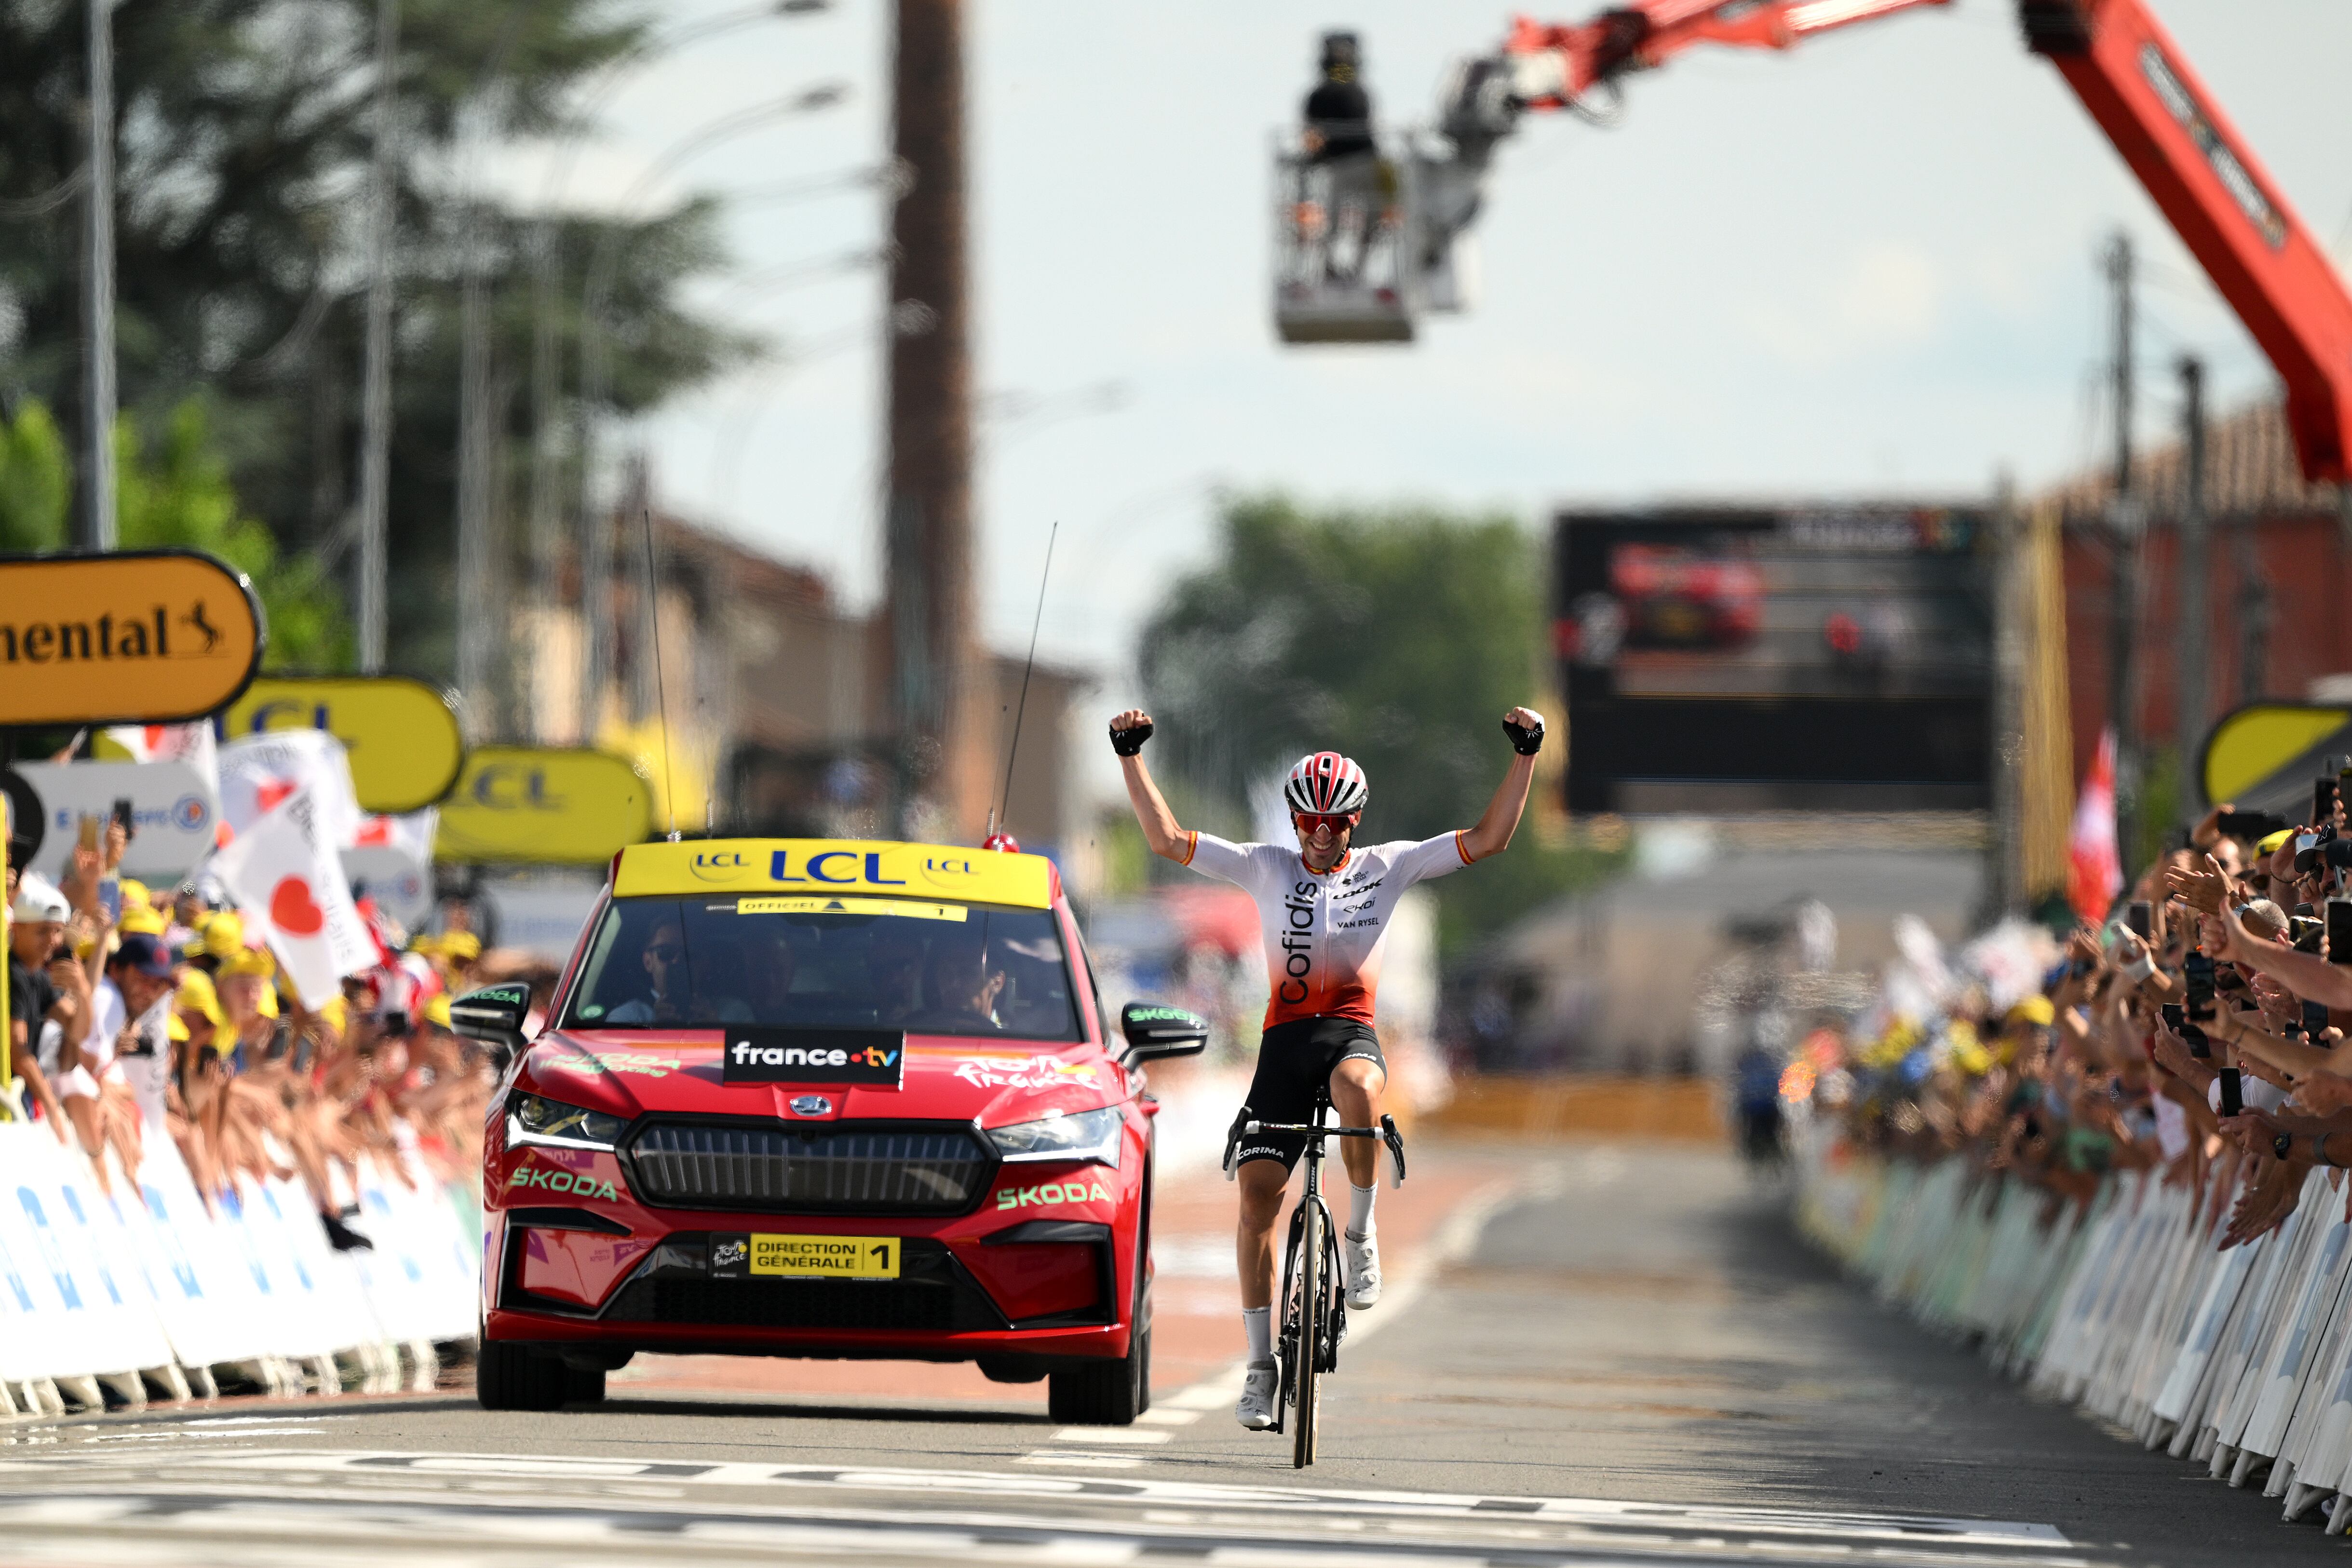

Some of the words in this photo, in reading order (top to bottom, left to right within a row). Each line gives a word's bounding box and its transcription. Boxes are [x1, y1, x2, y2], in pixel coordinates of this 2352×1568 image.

[697, 853, 750, 867] LCL
[927, 858, 980, 874] LCL
[771, 851, 906, 885] LCL
[1333, 878, 1384, 900] LOOK
[1358, 917, 1379, 927] RYSEL
[1280, 881, 1317, 1005] Cofidis
[1238, 1147, 1284, 1160] CORIMA
[757, 1242, 856, 1254] DIRECTION
[757, 1255, 855, 1269] GÉNÉRALE
[870, 1244, 889, 1270] 1
